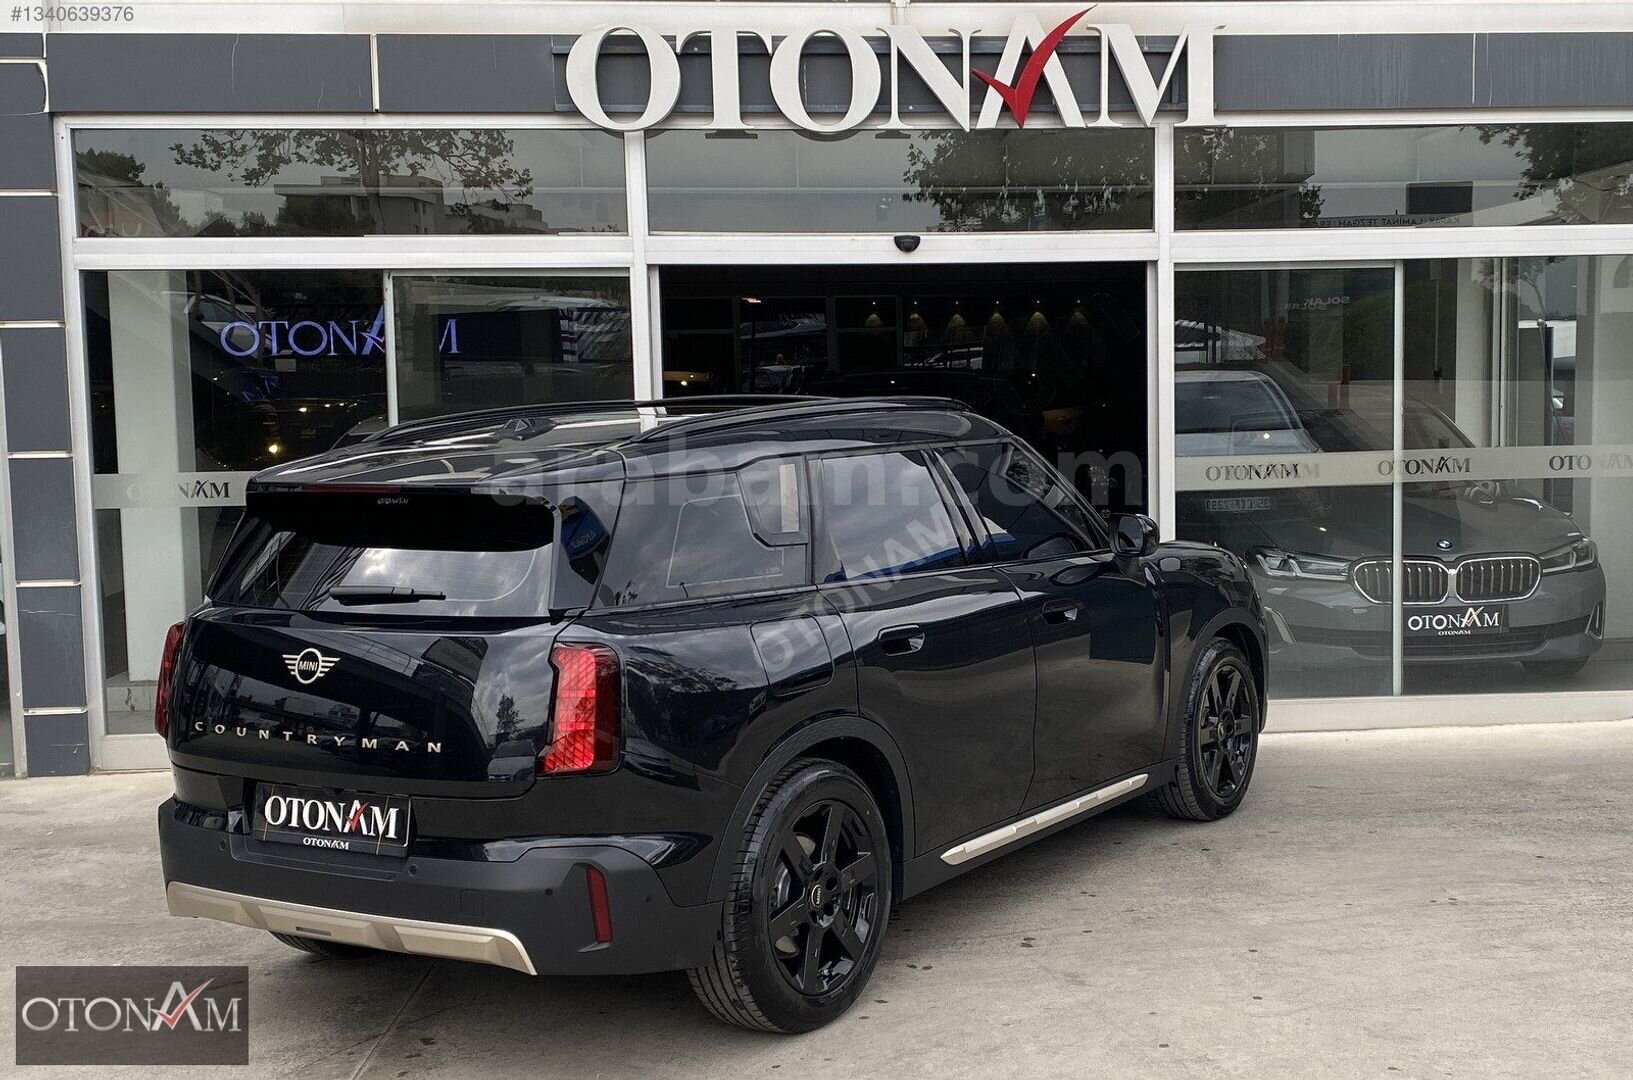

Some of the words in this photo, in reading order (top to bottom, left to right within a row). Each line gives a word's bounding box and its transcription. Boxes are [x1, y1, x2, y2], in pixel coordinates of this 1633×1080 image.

[566, 5, 1226, 133] OTONAM
[1378, 456, 1471, 476] OONAM
[1408, 606, 1500, 631] OTONAM
[298, 660, 318, 672] MINI
[194, 721, 442, 753] COUNTRYMAN
[264, 795, 399, 839] OTONAM
[303, 836, 350, 850] OTONAM
